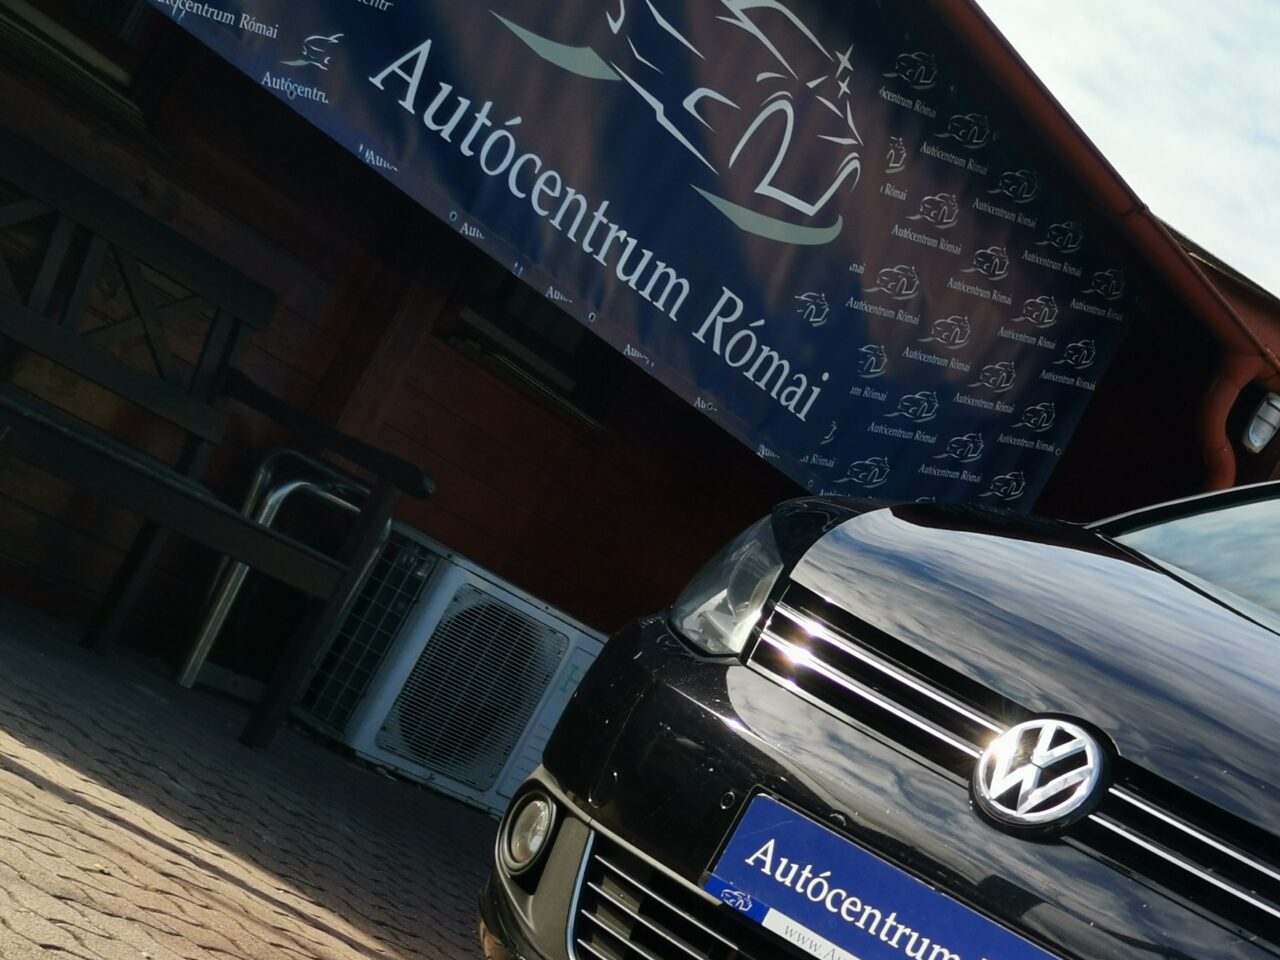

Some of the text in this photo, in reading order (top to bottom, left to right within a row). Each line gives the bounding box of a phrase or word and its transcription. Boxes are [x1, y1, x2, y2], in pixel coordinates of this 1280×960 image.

[238, 13, 280, 39] Római
[368, 38, 830, 422] Autócentrum Római
[892, 224, 938, 247] Autócentrum
[947, 277, 991, 298] Autócentrum
[845, 296, 896, 319] Autócentrum
[902, 346, 948, 367] Autócentrum
[867, 421, 914, 440] Autócentrum
